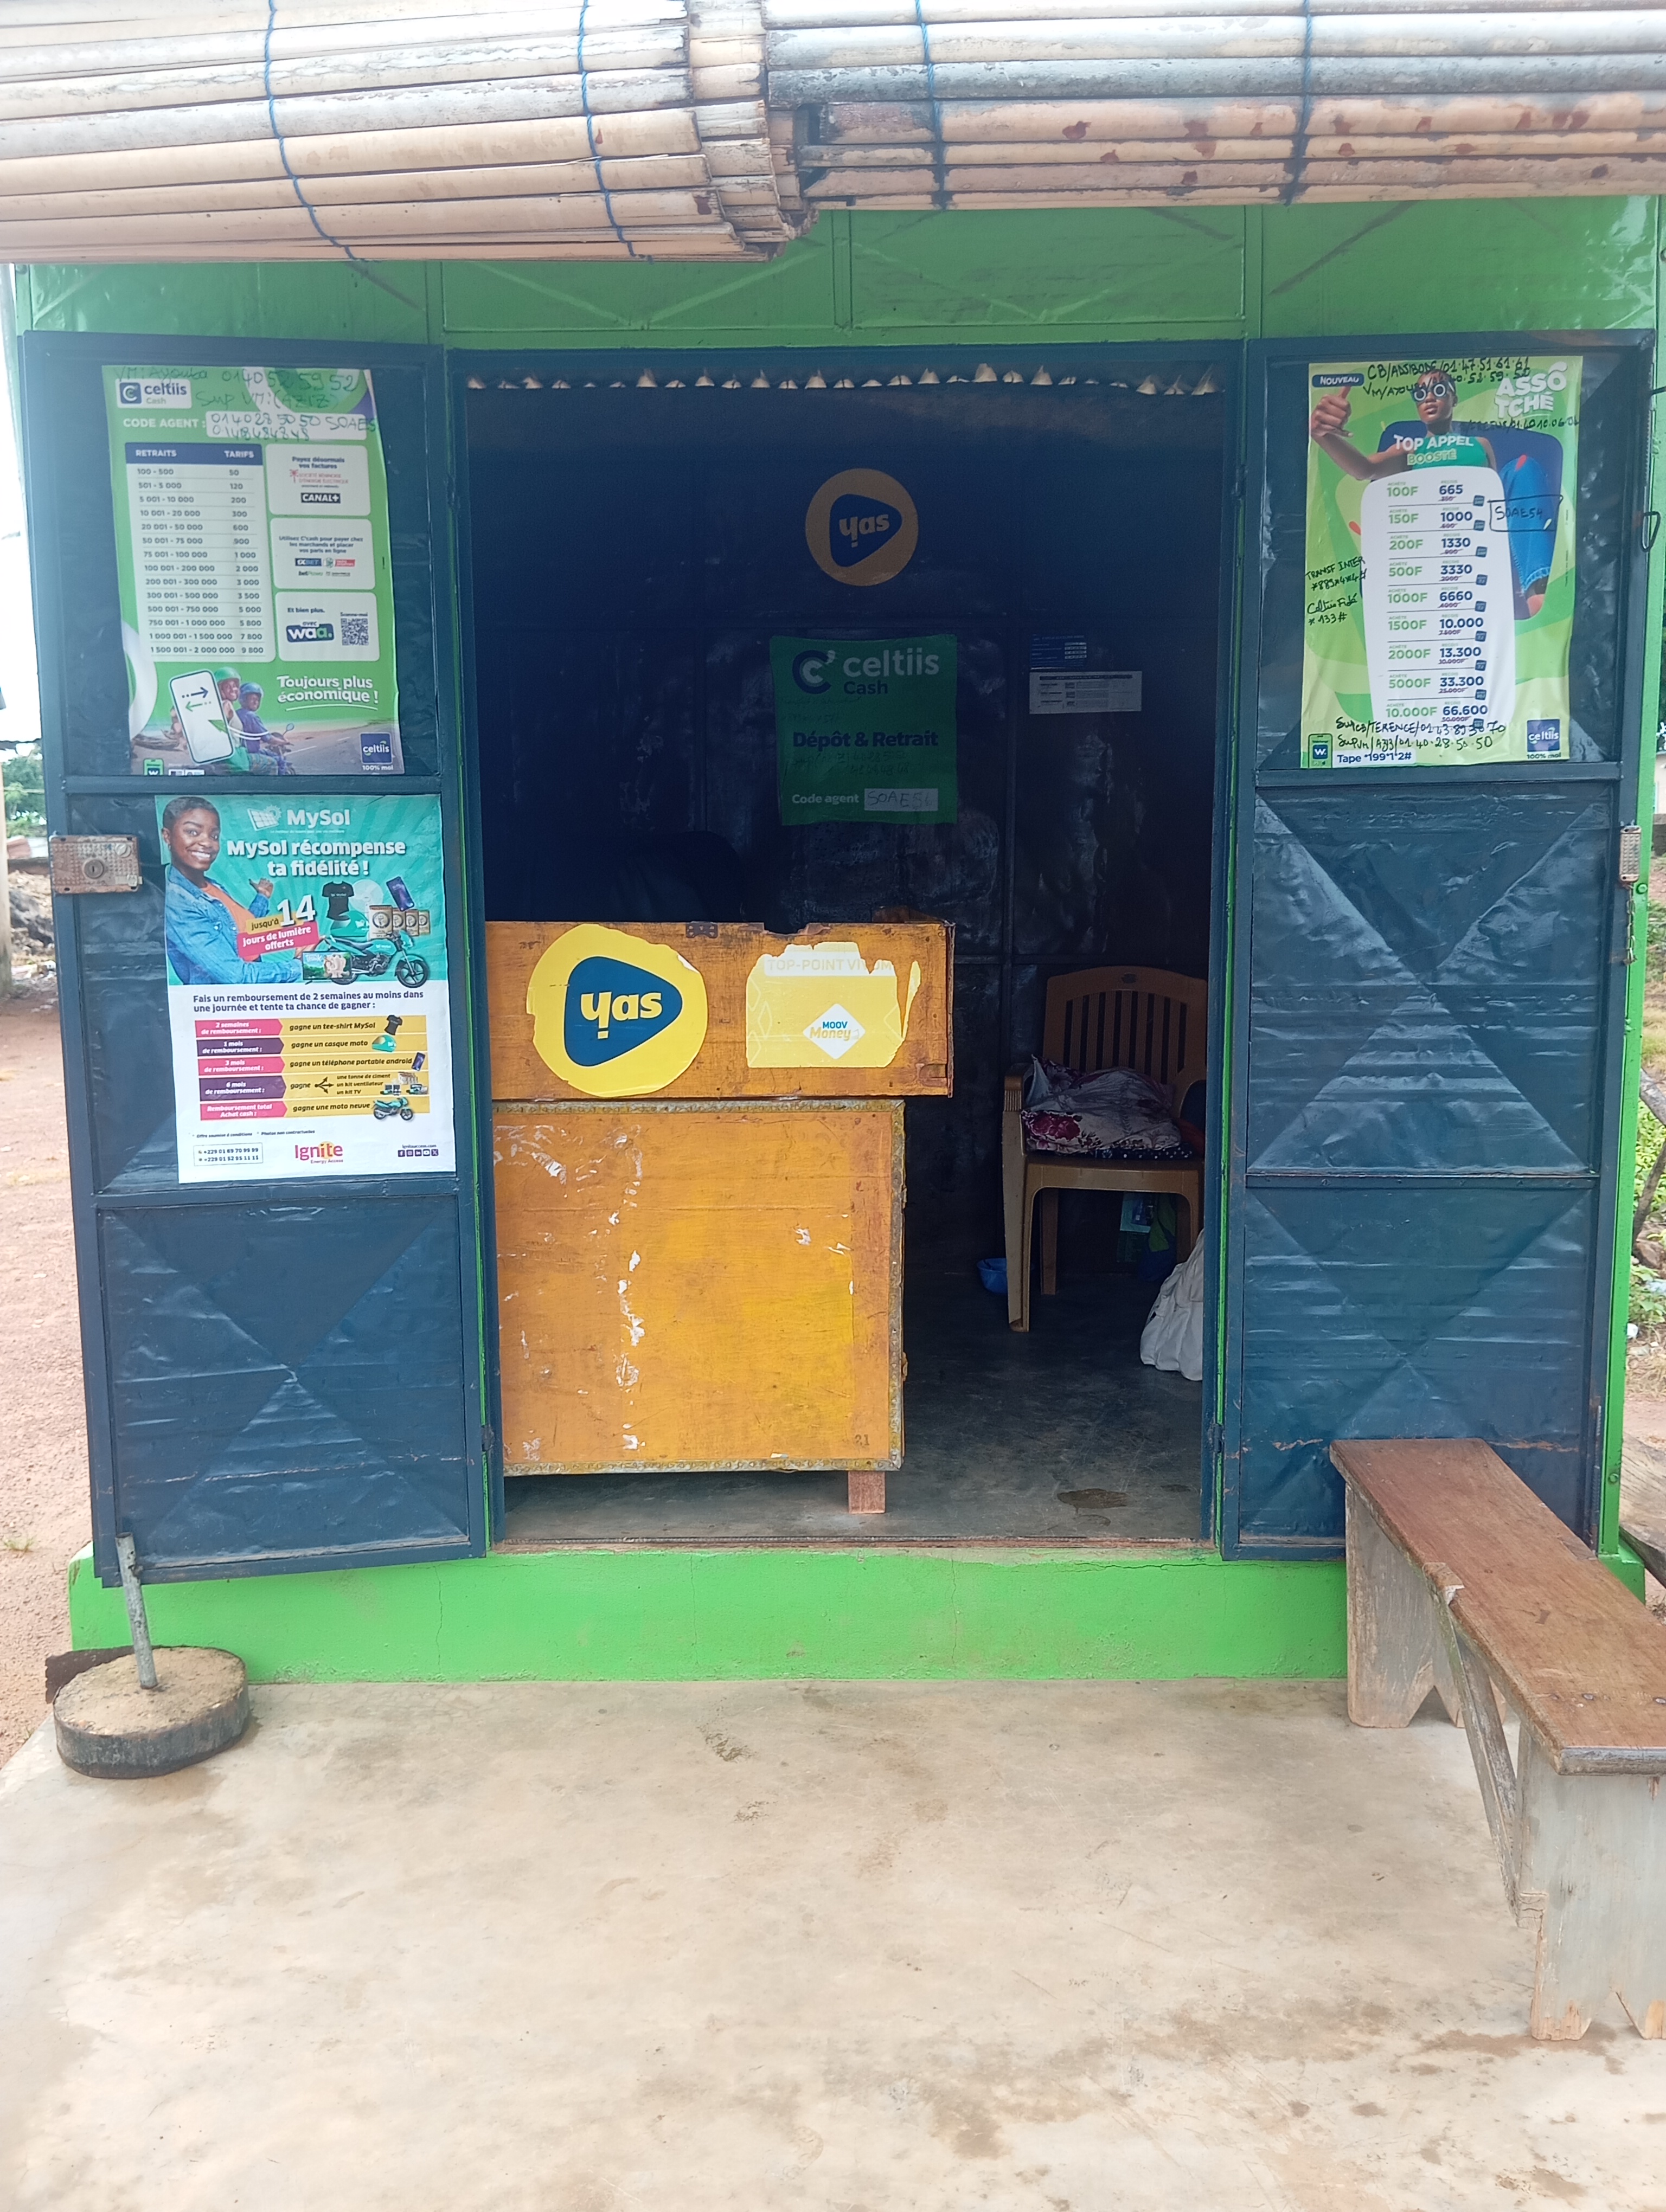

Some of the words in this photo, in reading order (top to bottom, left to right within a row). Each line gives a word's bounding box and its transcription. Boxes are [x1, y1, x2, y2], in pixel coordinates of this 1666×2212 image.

[1321, 376, 1359, 384] NOUVEAU
[144, 383, 187, 395] celtiis
[1495, 392, 1554, 418] TCHÉ
[123, 419, 156, 427] CODE
[159, 419, 199, 427] AGENT
[1394, 435, 1424, 451] TOP
[1426, 435, 1473, 448] APPEL
[1407, 449, 1457, 465] BOOSTÉ
[1387, 486, 1418, 497] 100F
[1439, 485, 1463, 494] 665
[303, 494, 339, 502] CANAL+
[1389, 513, 1419, 524] 150F
[1440, 511, 1473, 522] 1000
[839, 513, 890, 548] yas
[1389, 539, 1423, 550] 200F
[1441, 537, 1471, 548] 1330
[1389, 566, 1422, 576] 500F
[1440, 564, 1472, 575] 3330
[1388, 593, 1428, 603] 1000F
[1439, 591, 1473, 601] 6660
[1388, 620, 1427, 630] 1500F
[1440, 618, 1484, 628] 10.000
[1388, 649, 1431, 659] 2000F
[1440, 647, 1481, 658] 13.300
[843, 647, 939, 677] celtiis
[277, 675, 339, 689] Toujours
[343, 676, 373, 689] plus
[843, 680, 888, 695] Cash
[1389, 678, 1431, 689] 5000F
[1440, 676, 1484, 687] 33.300
[278, 687, 370, 703] économique
[1386, 706, 1437, 717] 10.000F
[1443, 705, 1488, 716] 66.600
[793, 730, 851, 752] Dépôt
[855, 732, 869, 748] &
[872, 730, 938, 747] Retrait
[1528, 731, 1559, 742] celtiis
[362, 744, 389, 753] celtiis
[1337, 755, 1361, 763] Tape
[792, 794, 822, 804] Code
[824, 795, 860, 805] agent
[287, 809, 350, 828] MySol
[227, 840, 287, 859] MySol
[292, 839, 406, 857] récompense
[267, 861, 287, 876] ta
[291, 859, 359, 876] fidélité
[363, 860, 369, 876] !
[277, 895, 316, 927] 14
[251, 918, 279, 930] jusqu'à
[243, 935, 265, 947] jours
[268, 933, 277, 941] de
[279, 926, 311, 938] lumière
[265, 938, 294, 950] offerts
[767, 959, 844, 970] TOP-POINT
[212, 1004, 247, 1013] journée
[341, 1002, 371, 1010] gagner
[581, 989, 663, 1039] yas
[810, 1027, 851, 1041] Money
[295, 1143, 343, 1161] Ignite
